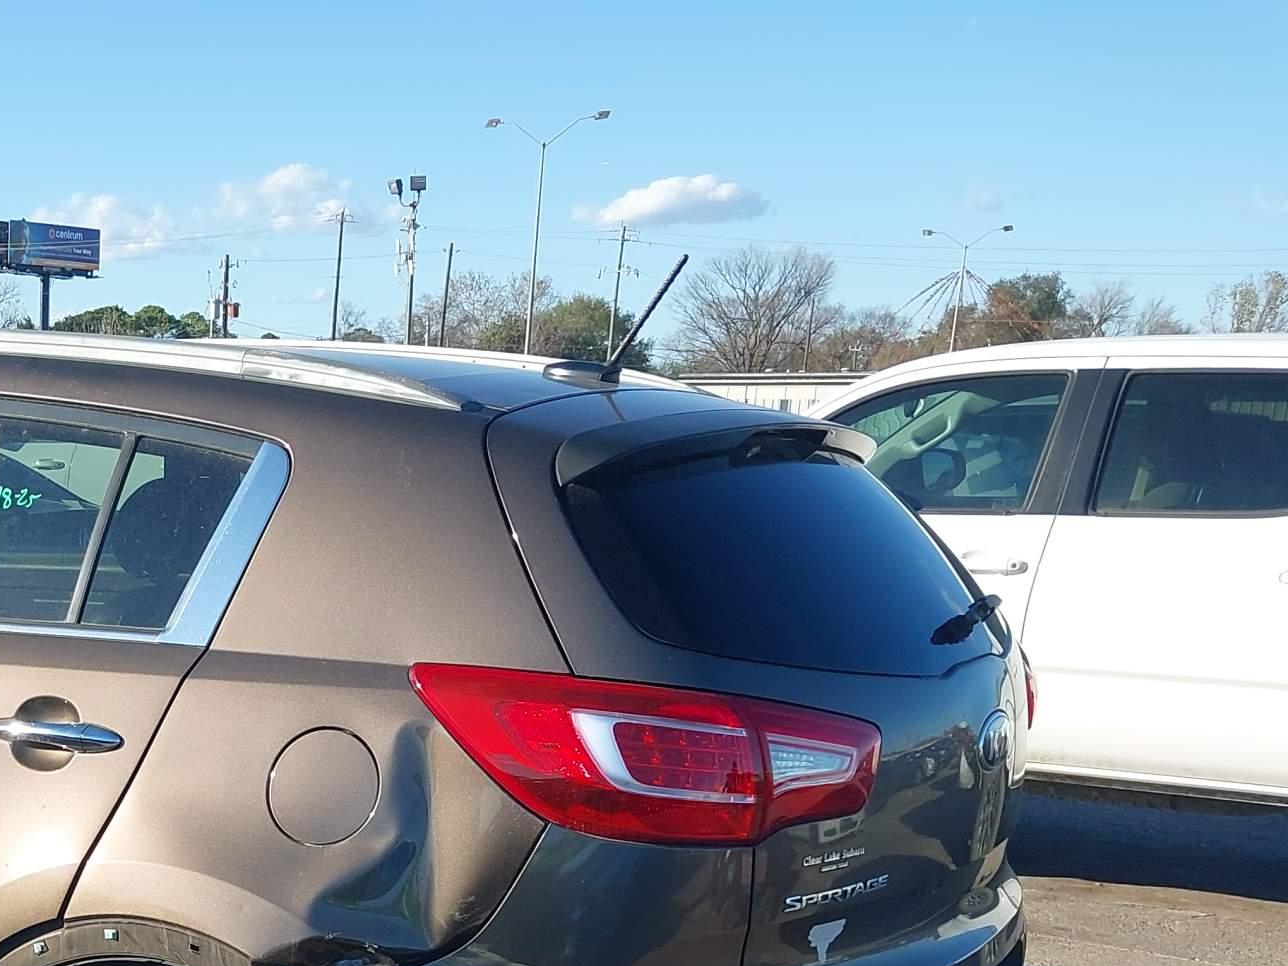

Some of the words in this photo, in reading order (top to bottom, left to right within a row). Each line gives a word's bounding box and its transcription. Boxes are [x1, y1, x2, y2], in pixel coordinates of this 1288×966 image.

[55, 229, 83, 241] centrum
[803, 855, 823, 867] Clear
[823, 851, 841, 863] Lake
[841, 846, 866, 859] Subaru
[784, 873, 889, 913] SPORTAGE
